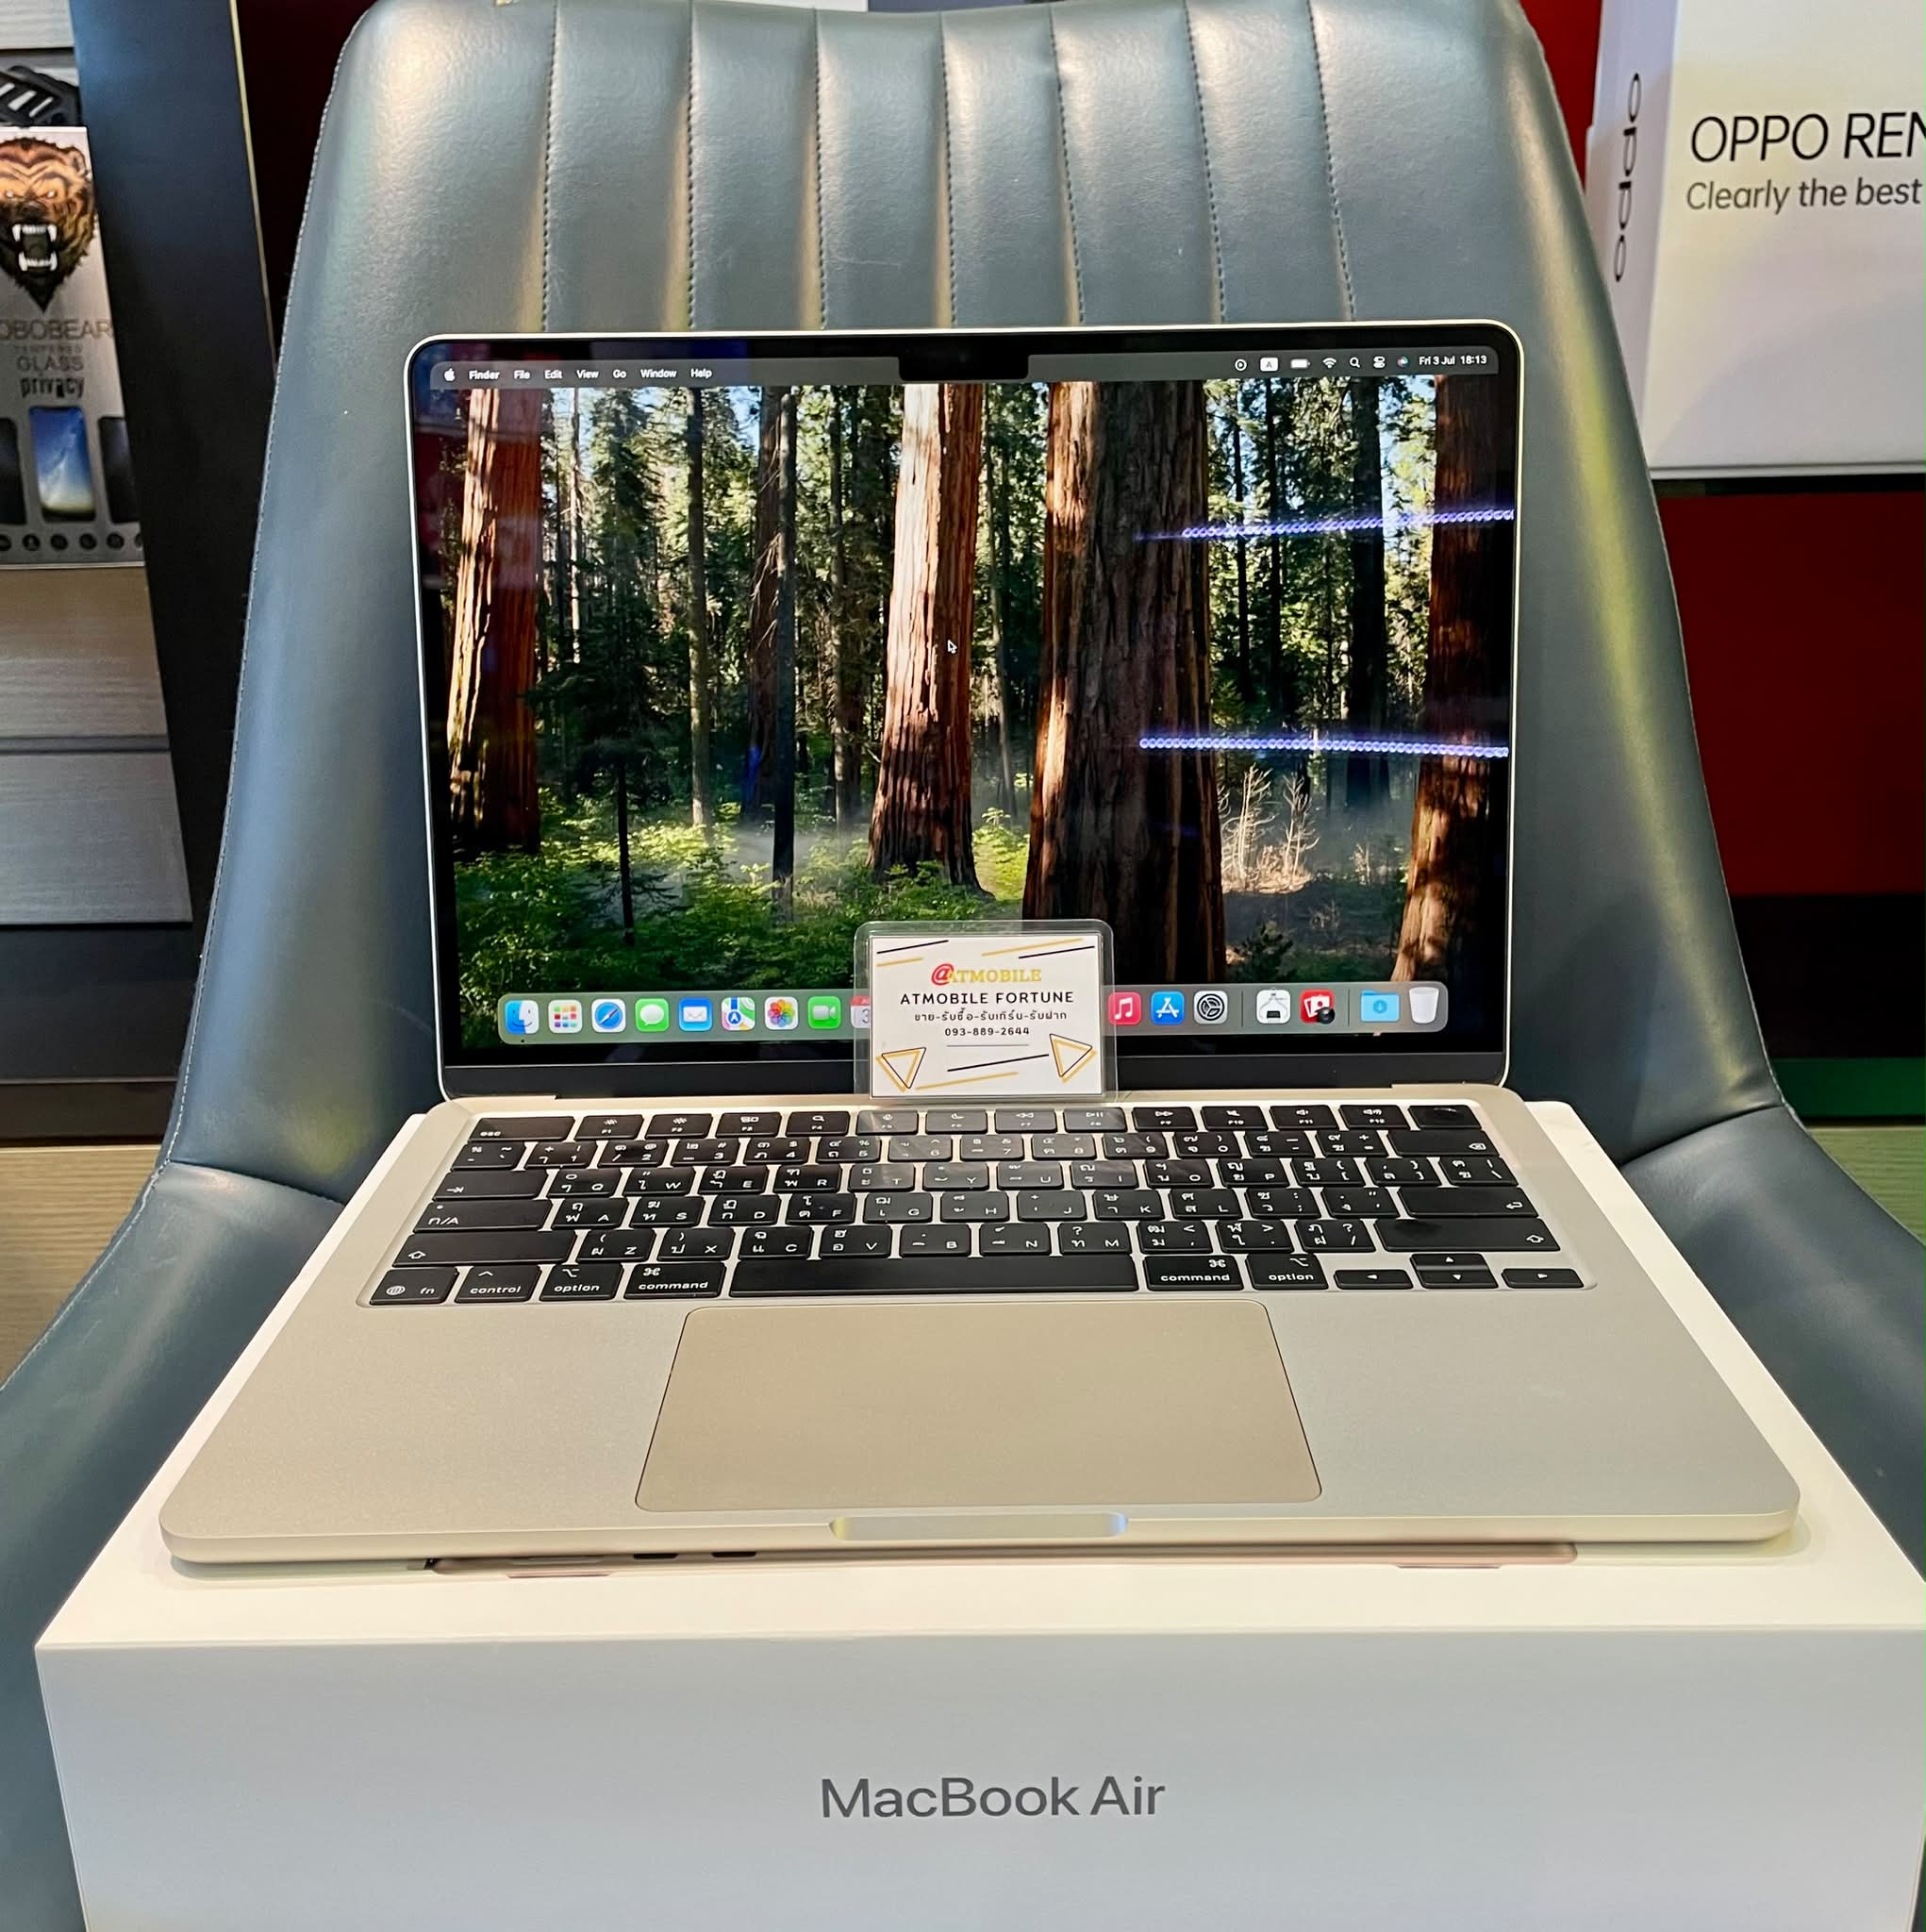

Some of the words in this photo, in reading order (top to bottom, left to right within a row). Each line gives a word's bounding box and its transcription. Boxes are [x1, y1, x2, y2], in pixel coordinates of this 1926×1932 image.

[1691, 113, 1829, 162] OPPO
[1686, 178, 1791, 215] Clearly
[1799, 177, 1847, 207] the
[1855, 176, 1922, 206] best
[17, 356, 84, 371] GLASS
[1419, 356, 1431, 365] Fri
[1432, 356, 1439, 365] 3
[1440, 356, 1454, 365] Jul
[1460, 355, 1487, 365] 18:13
[469, 370, 500, 380] Finder
[514, 370, 530, 379] File
[544, 369, 562, 379] Edit
[576, 369, 599, 379] View
[613, 369, 626, 379] Go
[640, 368, 676, 378] Window
[690, 368, 712, 379] Help
[21, 376, 85, 398] privacy
[900, 992, 988, 1005] ATMOBILE
[996, 991, 1073, 1004] FORTUNE
[945, 1027, 1030, 1037] 093-889-2644
[624, 1246, 637, 1255] Z
[555, 1284, 600, 1292] option
[822, 1776, 1080, 1818] MacBook
[1089, 1775, 1166, 1816] Air
